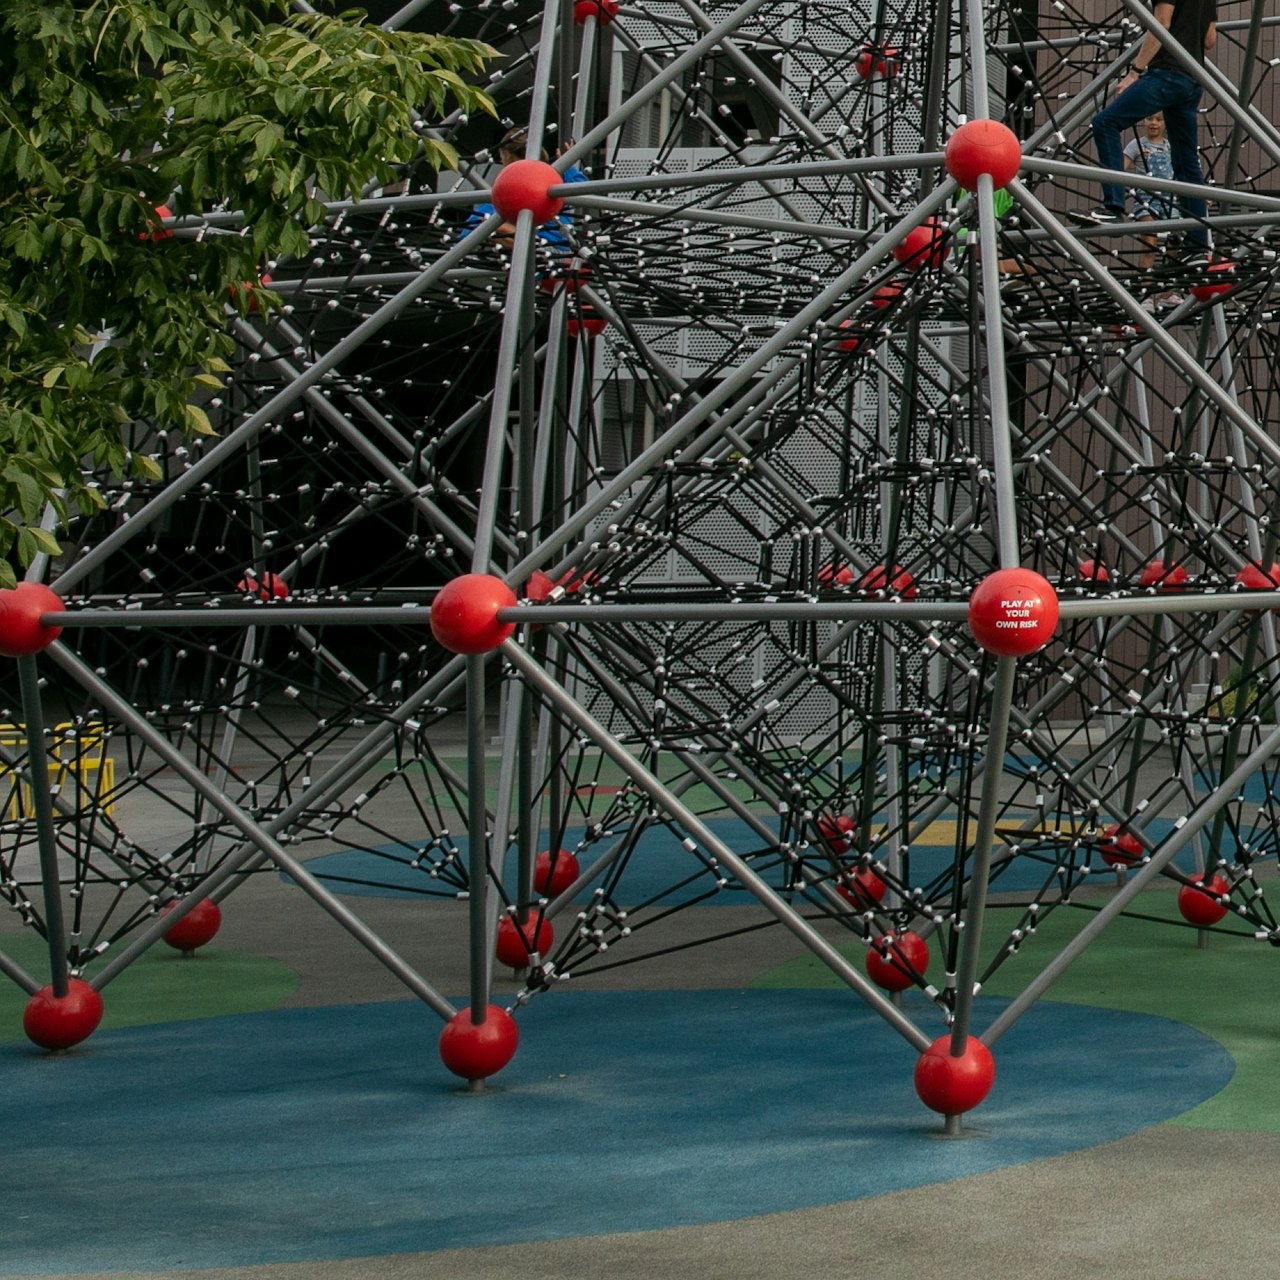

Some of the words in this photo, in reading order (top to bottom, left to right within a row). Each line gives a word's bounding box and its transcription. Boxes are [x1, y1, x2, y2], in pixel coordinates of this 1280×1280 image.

[1001, 600, 1022, 608] PLAY
[1024, 600, 1034, 608] AT
[1005, 609, 1029, 617] YOUR
[996, 620, 1018, 629] OWN
[1019, 620, 1038, 629] RISK
